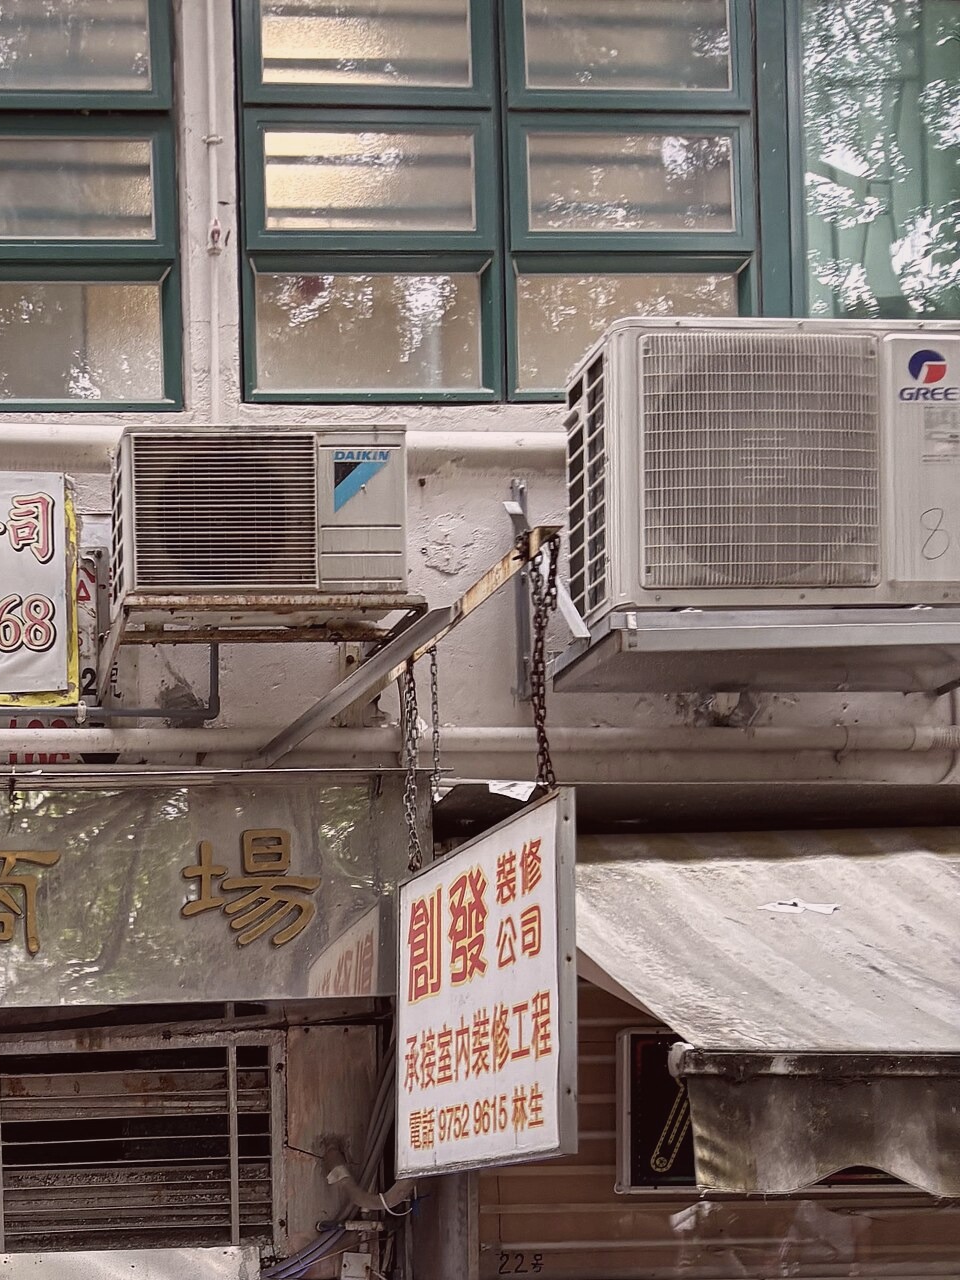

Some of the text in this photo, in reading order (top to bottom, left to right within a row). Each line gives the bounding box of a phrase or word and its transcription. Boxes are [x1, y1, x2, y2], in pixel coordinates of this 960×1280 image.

[898, 386, 960, 402] GREE
[333, 450, 390, 463] DAIKIN
[920, 507, 951, 560] 8
[495, 837, 544, 906] 裝修
[407, 864, 490, 1006] 創發
[496, 904, 543, 970] 公司
[409, 1082, 545, 1151] 電話 9752 9615 林生
